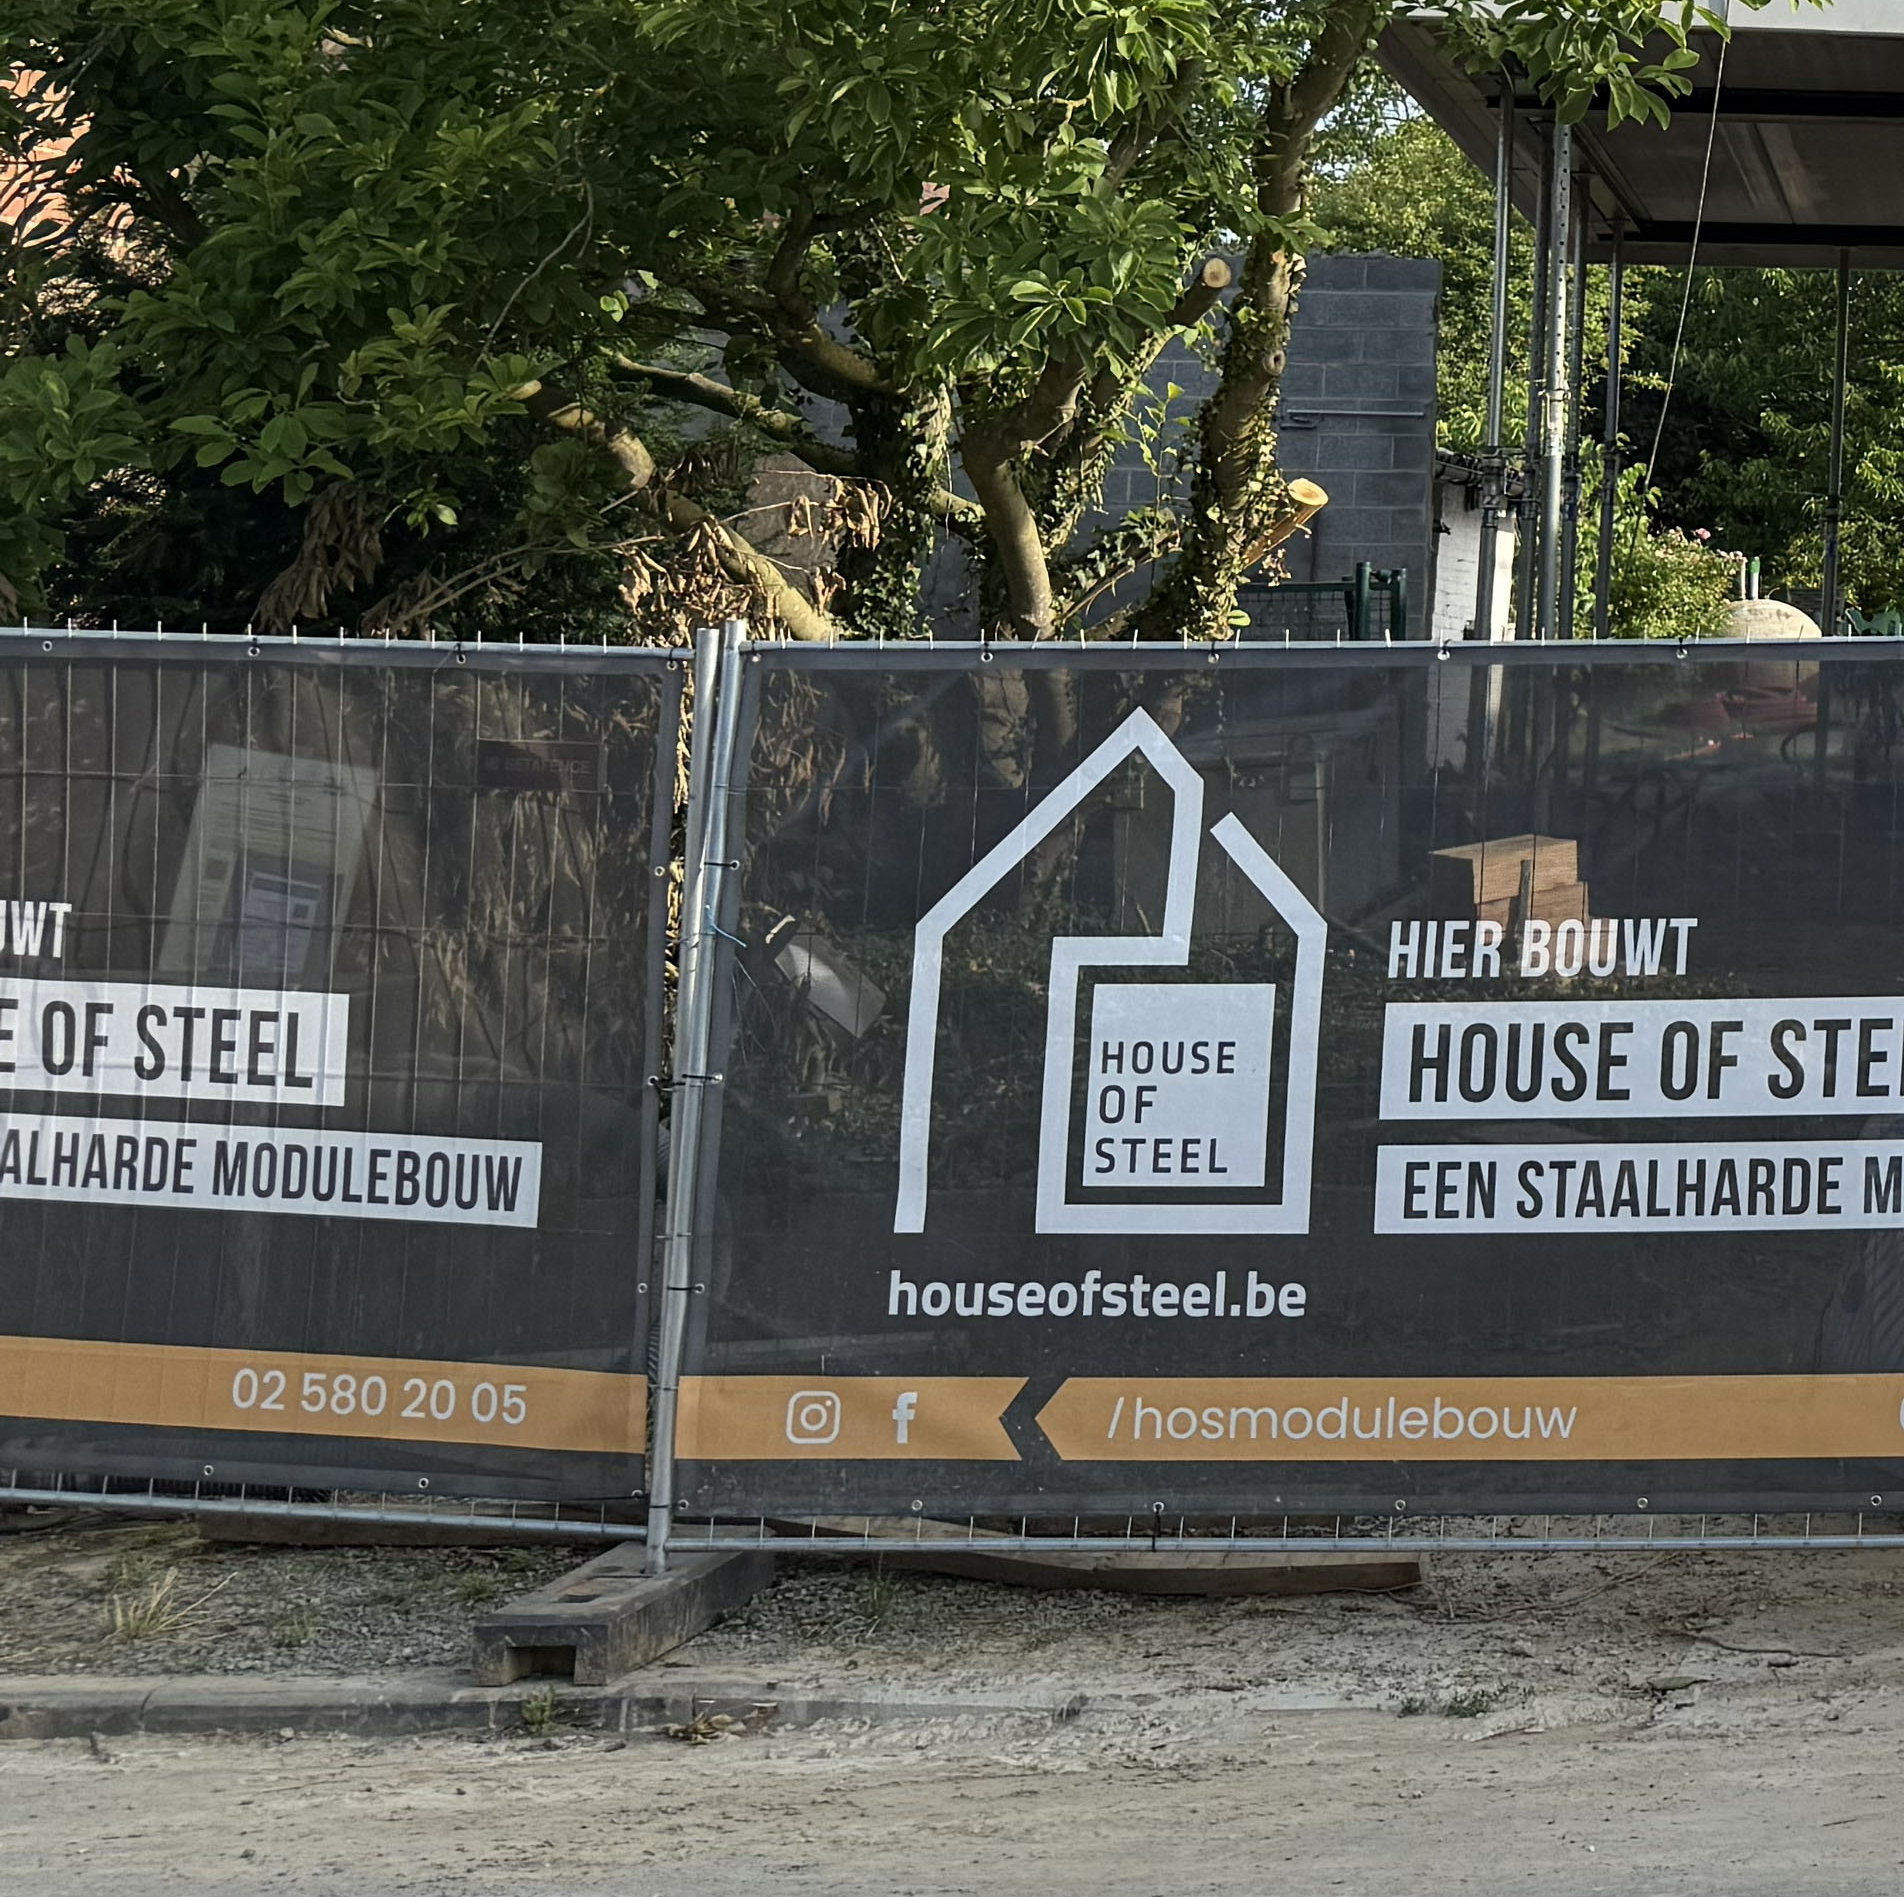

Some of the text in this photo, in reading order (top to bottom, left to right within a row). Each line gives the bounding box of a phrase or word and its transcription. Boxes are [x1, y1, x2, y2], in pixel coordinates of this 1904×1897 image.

[1388, 917, 1698, 979] HIER BOUWT
[42, 1000, 113, 1077] OF
[134, 1004, 314, 1088] STEEL
[1101, 1040, 1237, 1075] HOUSE
[1408, 1022, 1634, 1103] HOUSE
[1659, 1019, 1745, 1101] OF
[1099, 1085, 1155, 1124] OF
[212, 1138, 522, 1213] MODULEBOUW
[1094, 1138, 1228, 1174] STEEL
[1402, 1161, 1497, 1221] EEN
[1516, 1157, 1843, 1219] STAALHARDE
[887, 1270, 1308, 1318] houseofsteel.be
[233, 1367, 528, 1425] 02 580 20 05
[1107, 1396, 1578, 1443] /hosmodulebouw
